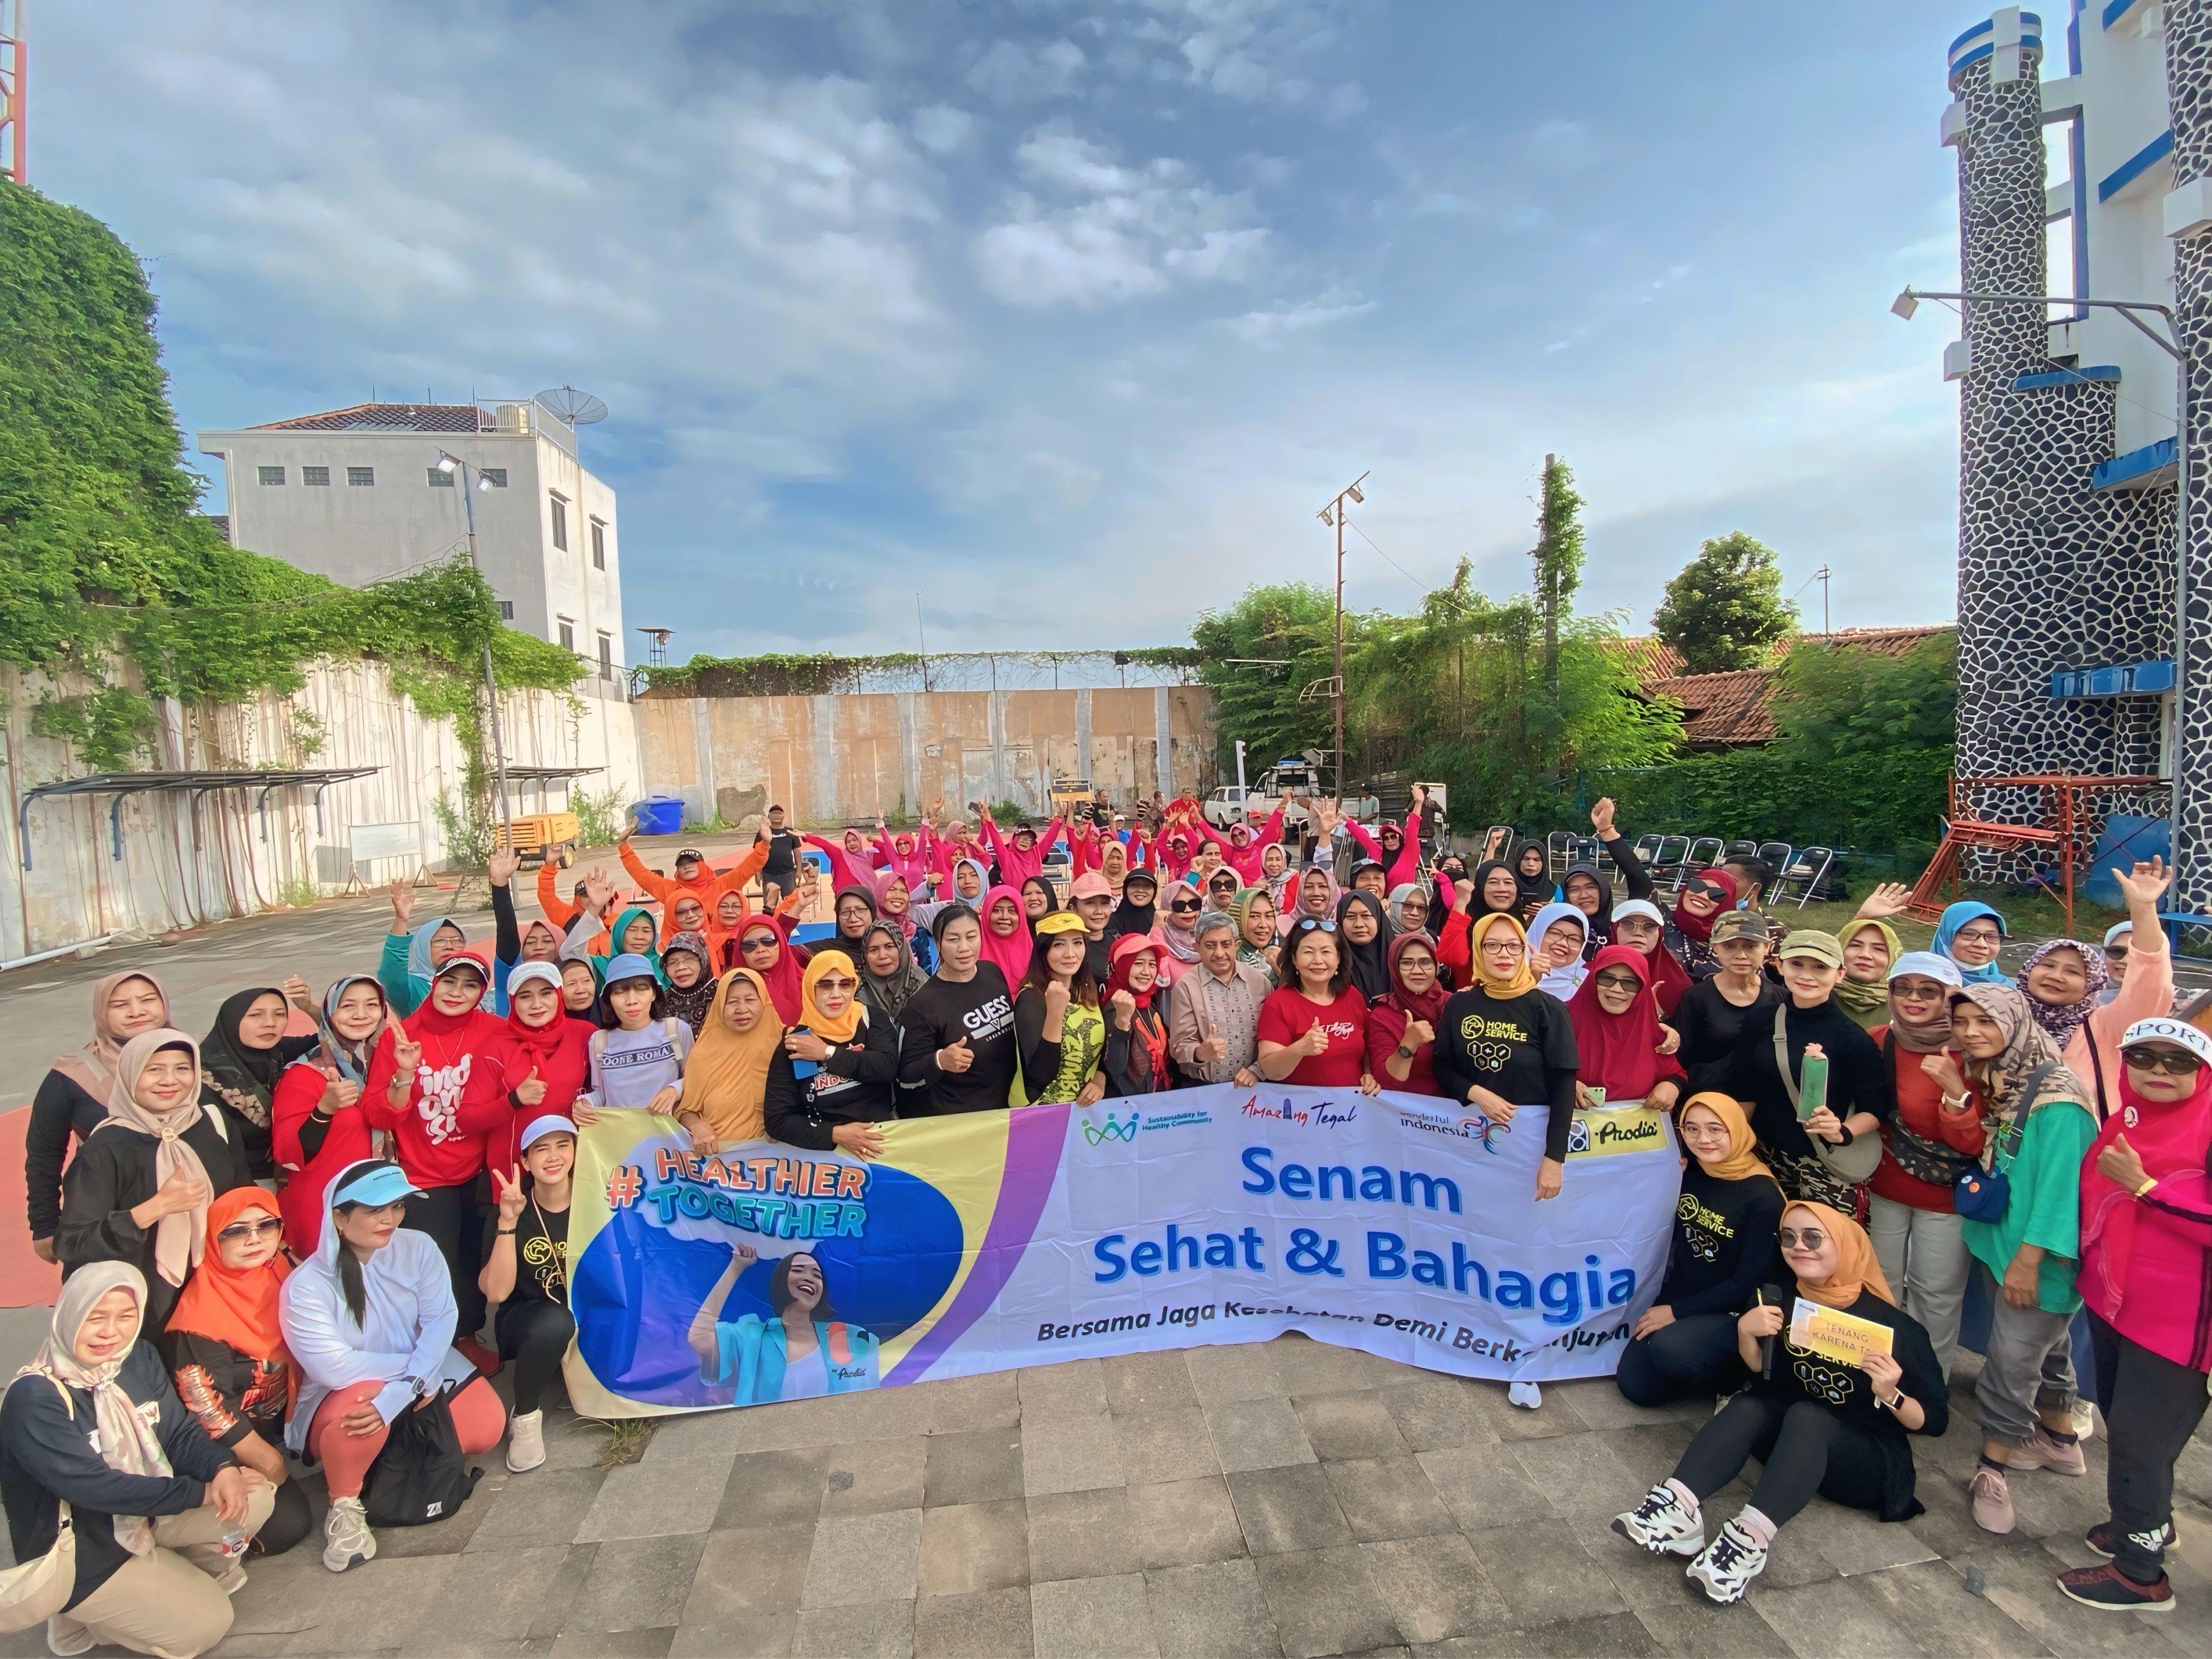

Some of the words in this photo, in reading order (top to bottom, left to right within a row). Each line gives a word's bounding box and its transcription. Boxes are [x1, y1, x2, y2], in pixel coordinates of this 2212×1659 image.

[963, 995, 1011, 1028] GUESS
[1484, 1028, 1528, 1042] SERVICE
[1486, 1021, 1517, 1032] HOME
[1310, 1102, 1358, 1130] Tegal
[1401, 1118, 1470, 1138] indonesia
[1599, 1120, 1658, 1145] Prodia
[655, 1147, 867, 1201] HEALTHIER
[1241, 1146, 1463, 1216] Senam
[646, 1185, 867, 1239] TOGETHER
[1699, 1206, 1726, 1225] HOME
[1094, 1224, 1266, 1283] Sehat
[1285, 1227, 1345, 1277] &
[1367, 1231, 1637, 1327] Bahagia
[1037, 1313, 1151, 1341] Bersama
[1156, 1304, 1215, 1327] Jaga
[1372, 1313, 1448, 1342] Demi
[1826, 1322, 1868, 1343] TENANG
[1812, 1330, 1856, 1351] KARENA
